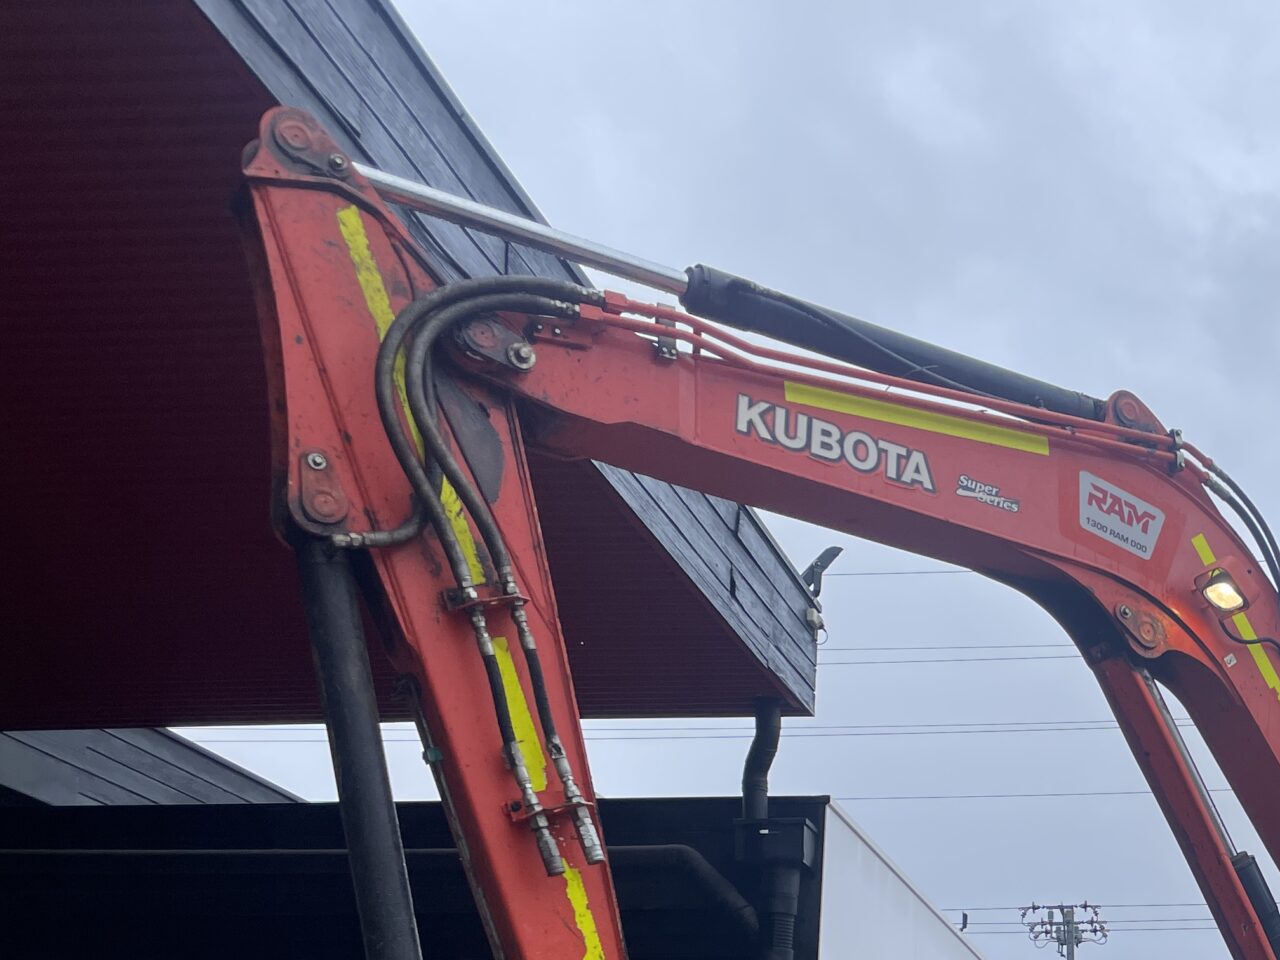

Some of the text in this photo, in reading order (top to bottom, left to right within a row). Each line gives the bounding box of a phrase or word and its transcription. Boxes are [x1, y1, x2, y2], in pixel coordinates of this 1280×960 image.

[735, 393, 935, 491] KUBOTA
[958, 475, 999, 495] Super
[977, 491, 1019, 512] Series
[1087, 482, 1157, 535] RAM
[1085, 516, 1108, 534] 1300
[1109, 528, 1129, 545] RAM
